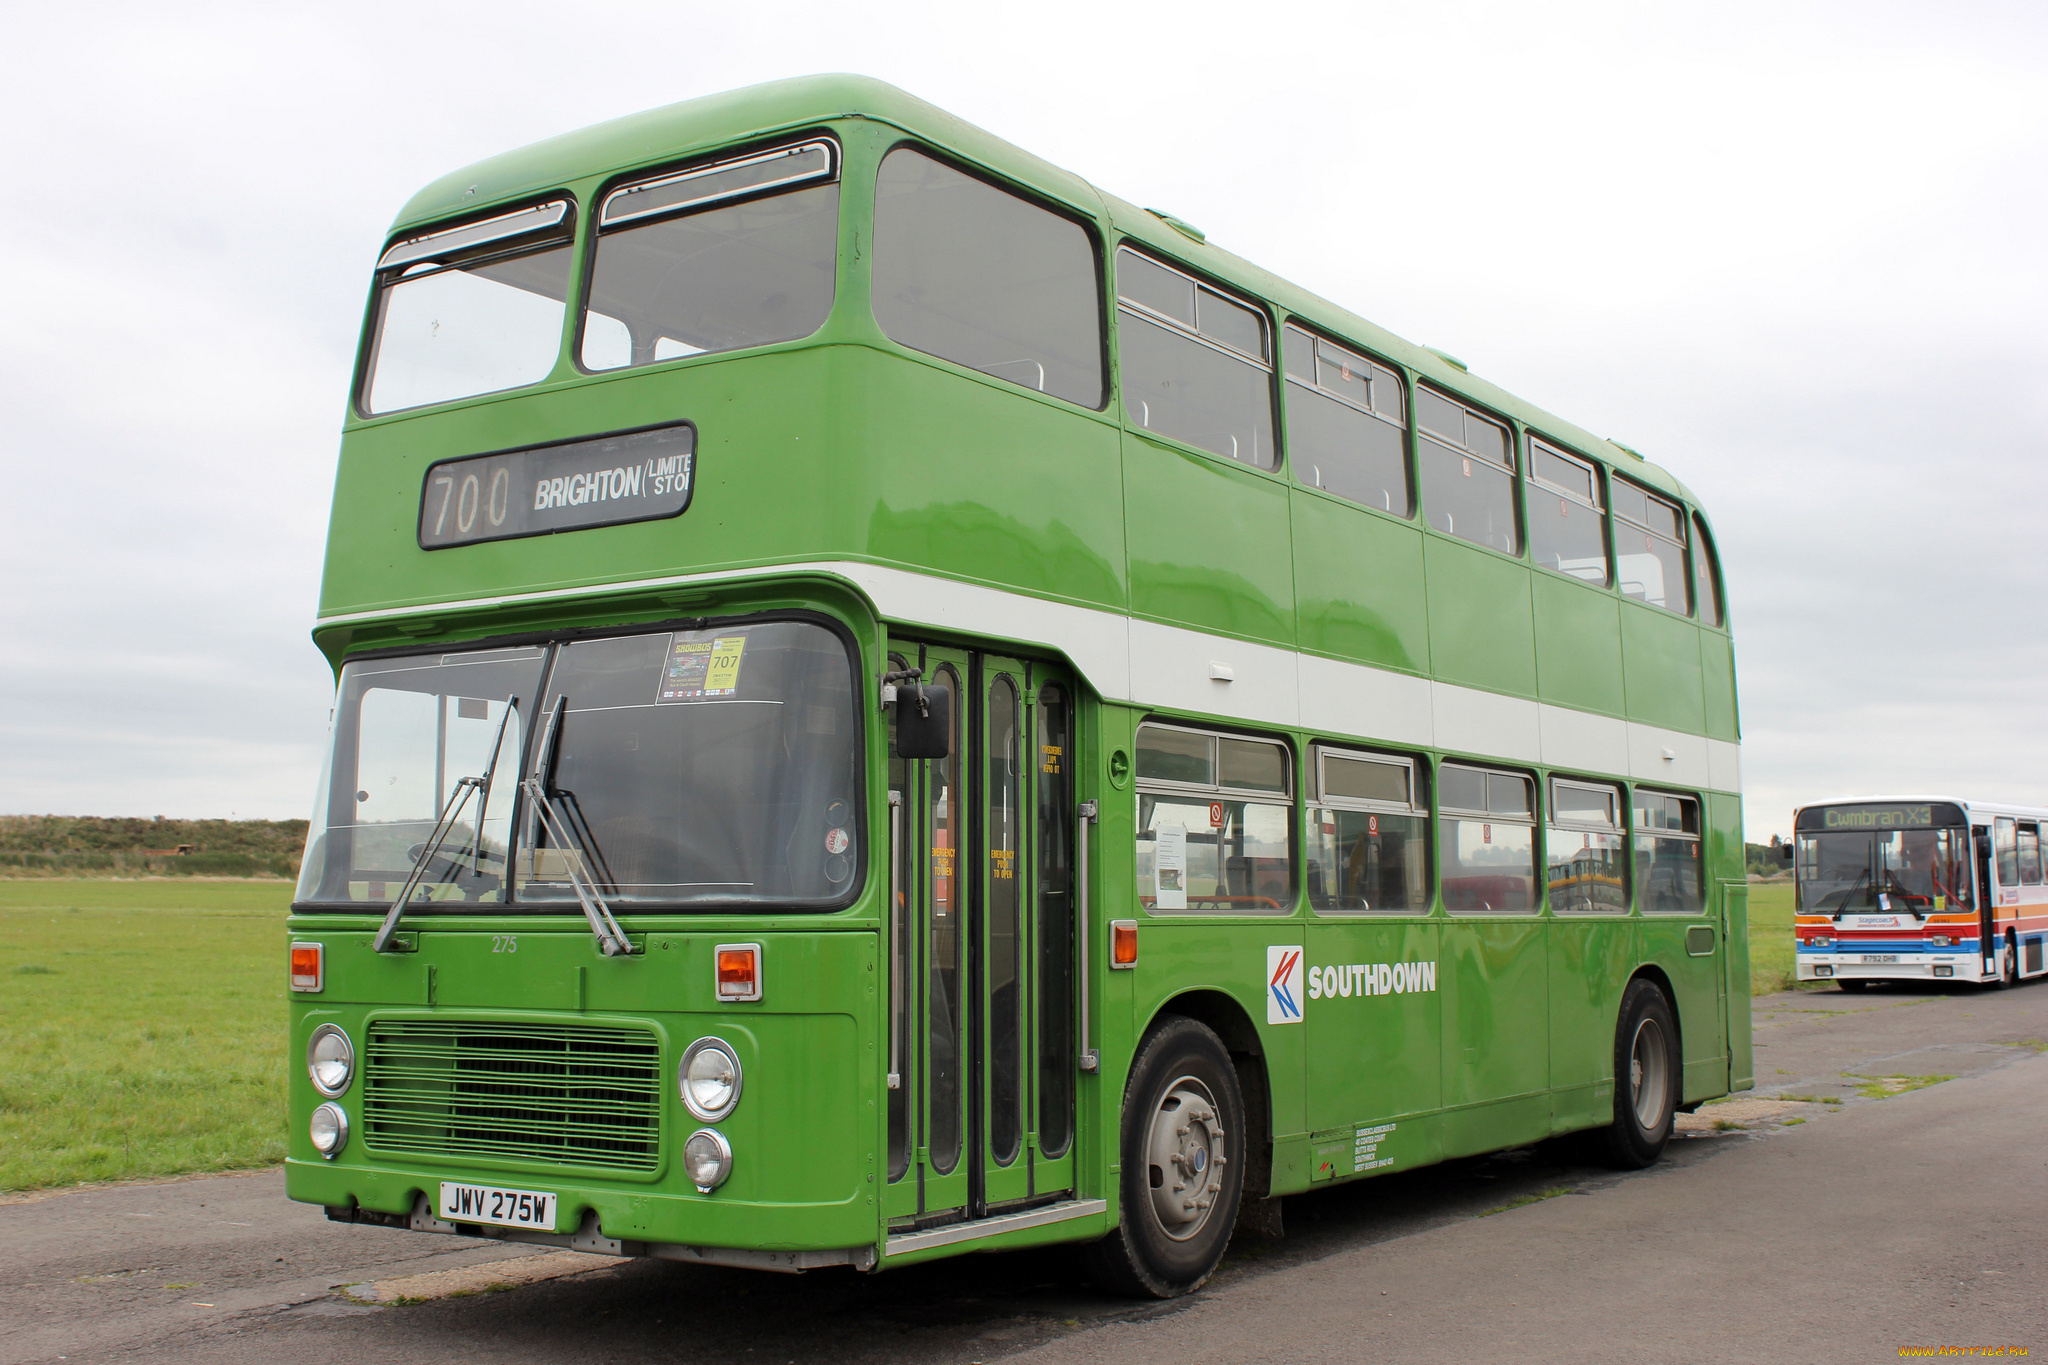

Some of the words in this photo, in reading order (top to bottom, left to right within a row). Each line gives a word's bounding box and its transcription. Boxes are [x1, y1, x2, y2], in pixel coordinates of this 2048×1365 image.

[434, 467, 509, 536] 700
[534, 465, 641, 511] BRIGHTON
[713, 655, 738, 669] 707
[1826, 809, 1904, 827] Cwmbran
[1907, 807, 1931, 825] X3
[931, 847, 955, 858] EMERGENCY
[991, 849, 1015, 860] EMERGENCY
[937, 858, 949, 866] PUSH
[997, 860, 1009, 869] PUSH
[934, 866, 940, 876] TO
[941, 867, 953, 876] OPEN
[993, 869, 1000, 878] TO
[1001, 869, 1013, 879] OPEN
[1858, 916, 1893, 925] Stagecoach
[492, 935, 517, 953] 275
[1308, 961, 1436, 1000] SOUTHDOWN
[449, 1188, 485, 1216] JWV
[491, 1191, 546, 1223] 275W
